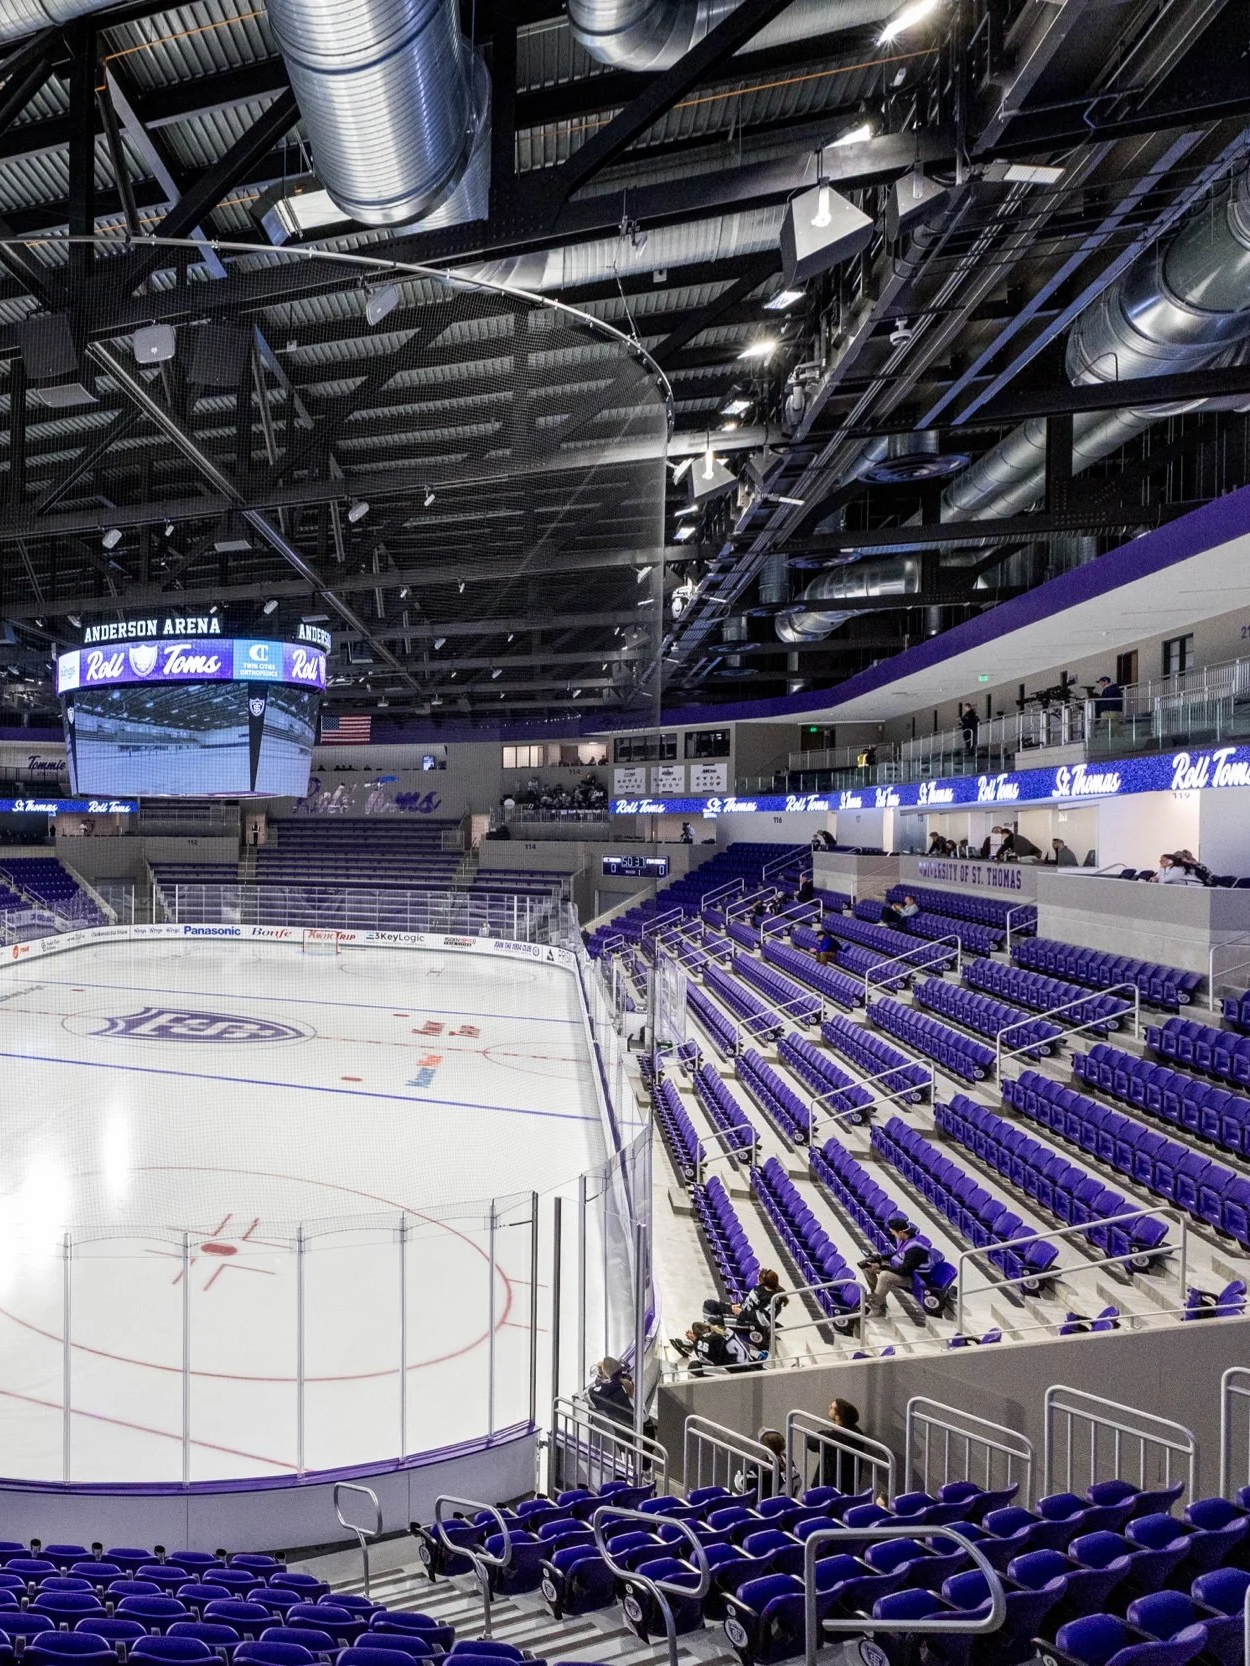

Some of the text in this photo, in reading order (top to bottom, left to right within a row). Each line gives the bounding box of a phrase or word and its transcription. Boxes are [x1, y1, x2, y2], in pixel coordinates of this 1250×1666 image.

[84, 617, 221, 643] ANDERSON ARENA
[86, 644, 222, 681] Roll Toms
[291, 649, 318, 681] Roll
[28, 755, 67, 771] Tommie
[1170, 747, 1250, 790] Roll Tom
[977, 773, 1020, 802] Roll Toms
[1070, 763, 1122, 797] Thomas
[927, 781, 954, 804] Thomas
[1172, 792, 1191, 800] 119
[24, 800, 58, 812] Thomas
[88, 801, 131, 813] Roll Toms
[615, 799, 666, 814] Roll Toms
[721, 797, 758, 813] Thomas
[785, 794, 829, 812] Roll Toms
[773, 816, 783, 824] 116
[960, 864, 969, 883] OF
[972, 865, 984, 885] ST.
[987, 867, 1022, 889] THOMAS
[183, 925, 241, 936] Panasonic
[252, 927, 292, 939] Bonfe
[375, 931, 425, 943] 3KeyLogic
